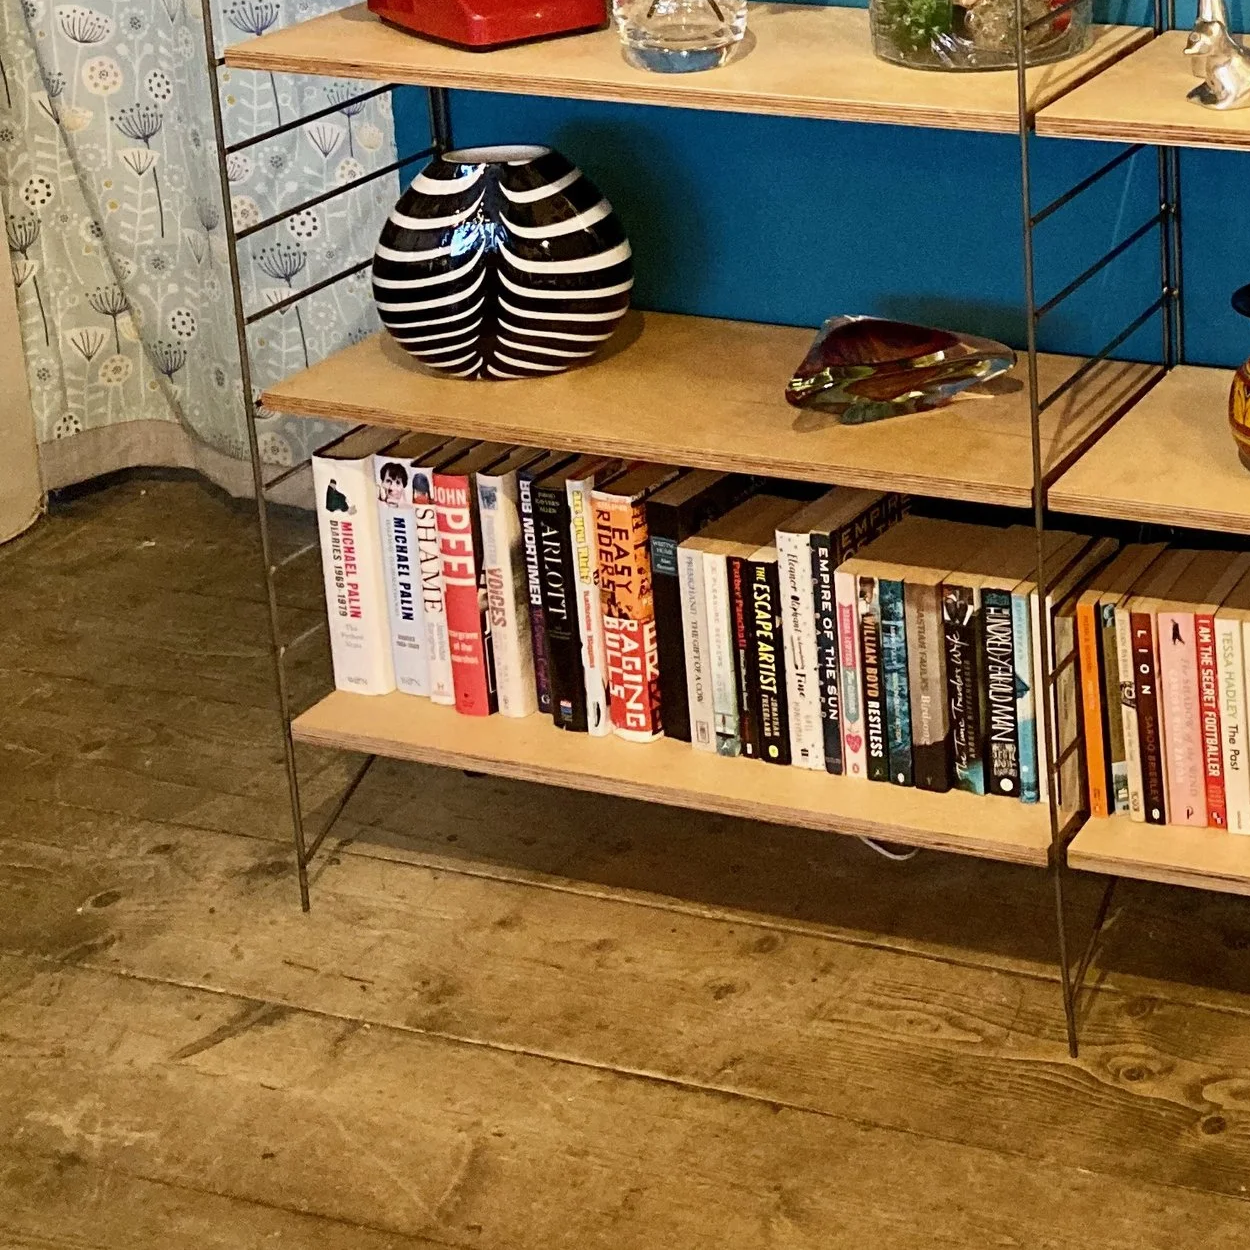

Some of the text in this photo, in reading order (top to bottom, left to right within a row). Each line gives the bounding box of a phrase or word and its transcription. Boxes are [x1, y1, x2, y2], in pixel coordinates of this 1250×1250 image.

[330, 520, 341, 561] DIARIES
[393, 517, 410, 577] MICHAEL
[415, 508, 443, 613] SHAME
[438, 508, 476, 592] PEEL
[519, 479, 542, 605] BOB MORTIMER
[573, 516, 586, 543] you
[595, 509, 615, 592] RIDERS
[612, 528, 632, 595] EASY
[340, 521, 362, 619] MICHAEL PALIN
[399, 582, 414, 621] PALIN
[488, 568, 507, 628] VOICES
[541, 521, 567, 620] ARLOTT
[786, 553, 803, 633] Eleanor Oliphant
[603, 615, 626, 699] BULLS
[691, 621, 701, 673] THE GIFT OF
[753, 566, 777, 694] THE ESCAPE ARTIST
[818, 547, 839, 721] EMPIRE OF THE SUN
[1198, 624, 1211, 642] AM
[1200, 645, 1213, 666] THE
[619, 618, 645, 728] RAGING
[795, 673, 807, 698] Fine
[862, 616, 883, 758] WILLIAM BOYD RESTLESS
[946, 630, 970, 780] The Time Wife
[1202, 669, 1216, 708] SECRET
[1222, 631, 1240, 771] TESSA HADLEY The Past
[920, 695, 931, 745] Birdsong
[991, 704, 1015, 742] MAN
[1145, 716, 1155, 751] SAROO
[1182, 678, 1193, 727] SHADOW
[1189, 765, 1198, 797] WIND
[1204, 711, 1221, 777] FOOTBALLER
